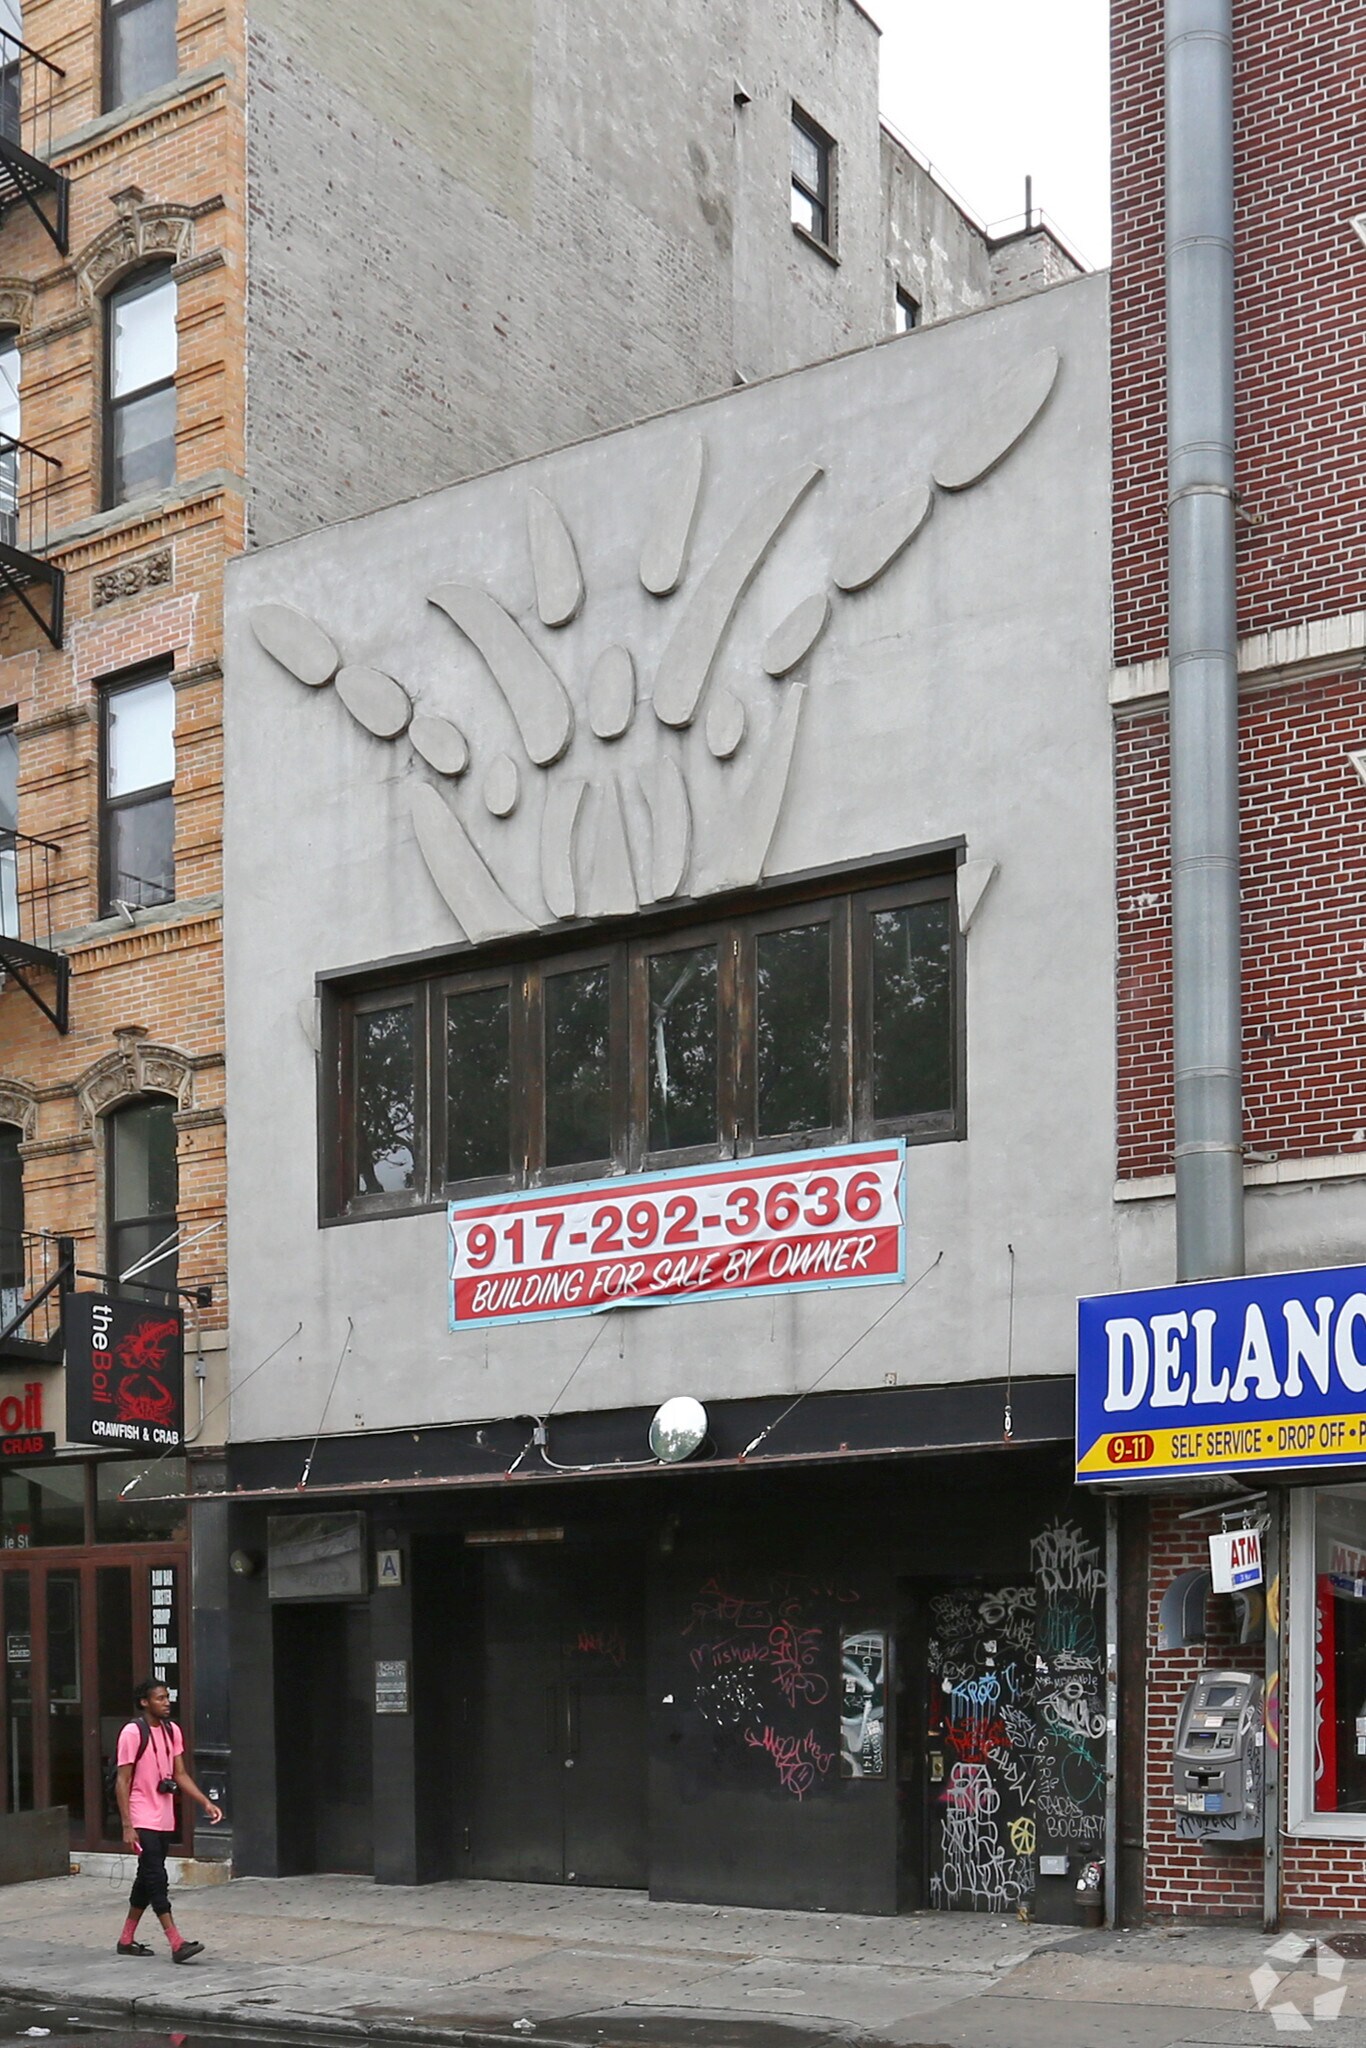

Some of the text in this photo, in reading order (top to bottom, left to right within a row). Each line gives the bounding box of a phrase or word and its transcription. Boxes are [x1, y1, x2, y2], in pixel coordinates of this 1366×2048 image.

[467, 1171, 882, 1269] 917-292-3636
[471, 1234, 877, 1313] BUILDING FOR SALE BY OWNER
[2, 1435, 45, 1456] CRAB
[92, 1419, 179, 1445] CRAWFISH & CRAB
[1112, 1435, 1147, 1462] 9-11
[1171, 1433, 1203, 1459] SELF
[1206, 1428, 1262, 1456] SERVICE
[1278, 1424, 1316, 1451] DROP
[1319, 1421, 1345, 1448] OFF
[17, 1534, 30, 1549] St
[1231, 1534, 1259, 1569] ATM
[382, 1555, 397, 1576] A
